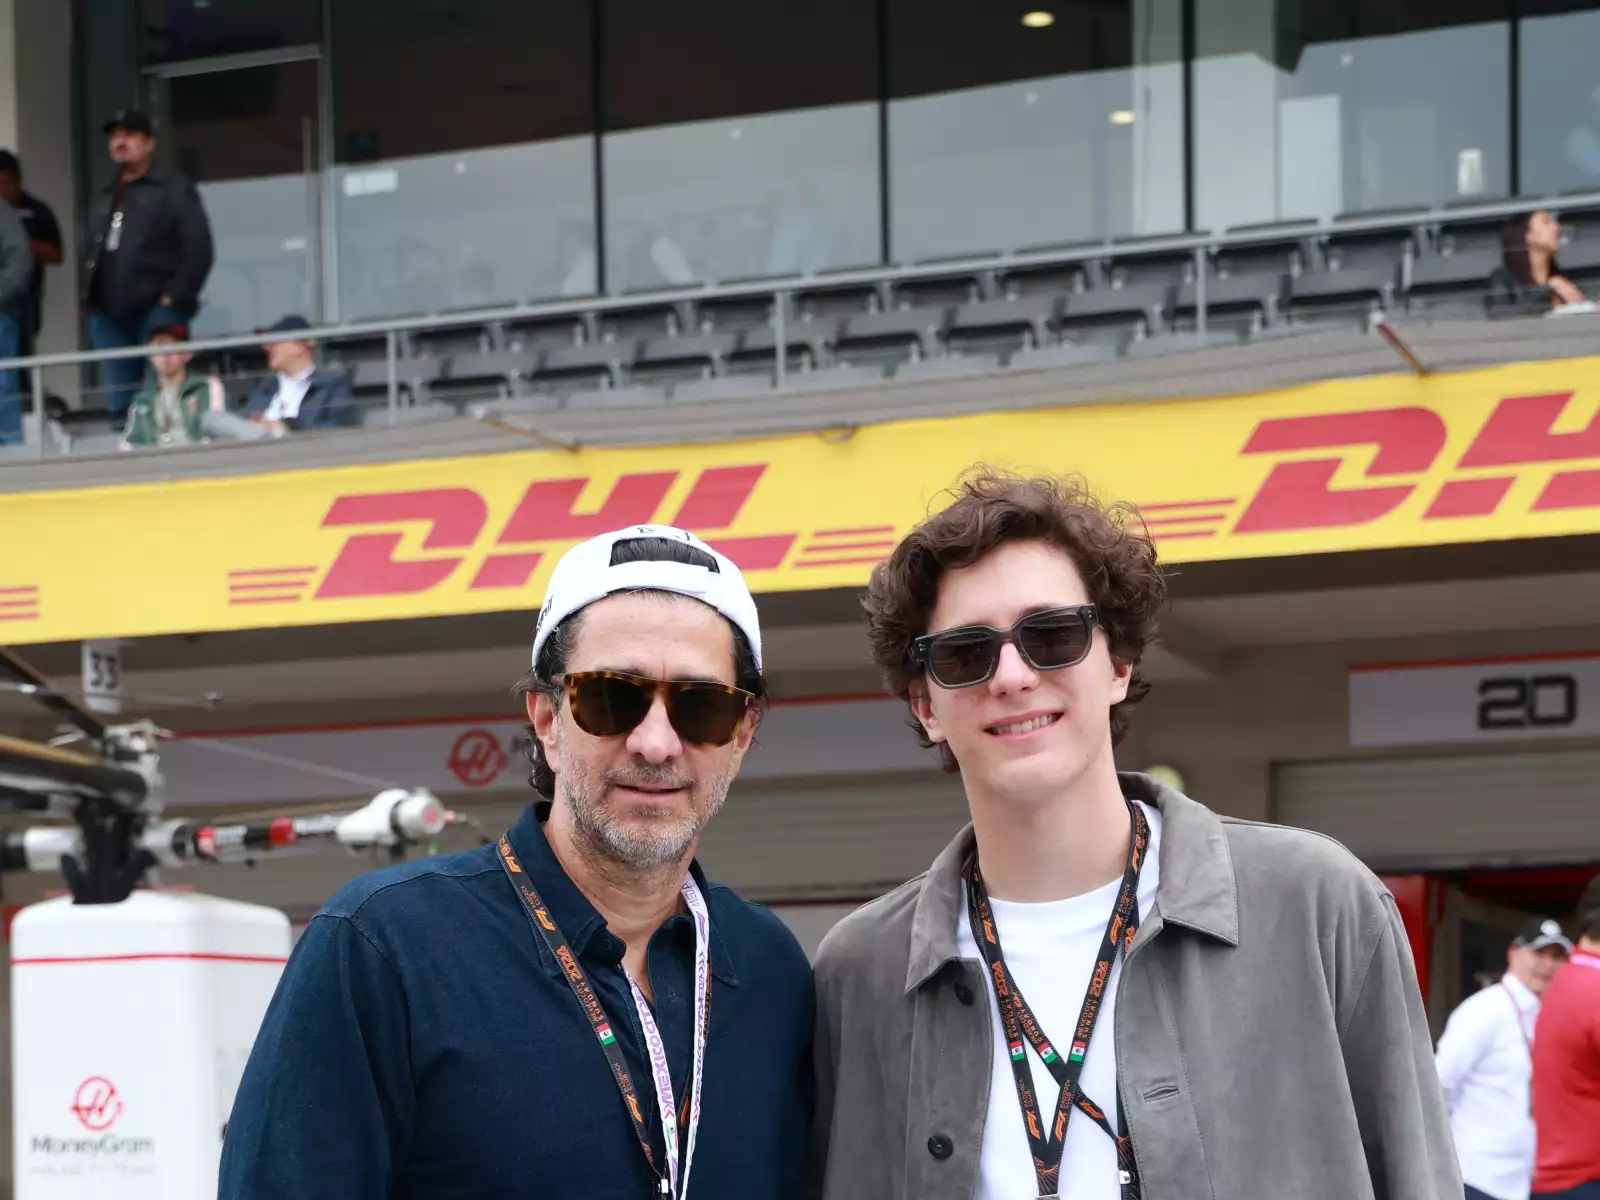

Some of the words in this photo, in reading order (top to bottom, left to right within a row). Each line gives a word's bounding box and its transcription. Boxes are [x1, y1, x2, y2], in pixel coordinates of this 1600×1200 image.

[313, 463, 798, 599] DHL
[1476, 674, 1578, 731] 20
[1081, 1000, 1097, 1039] SUNDAY
[31, 1135, 155, 1157] MoneyGram
